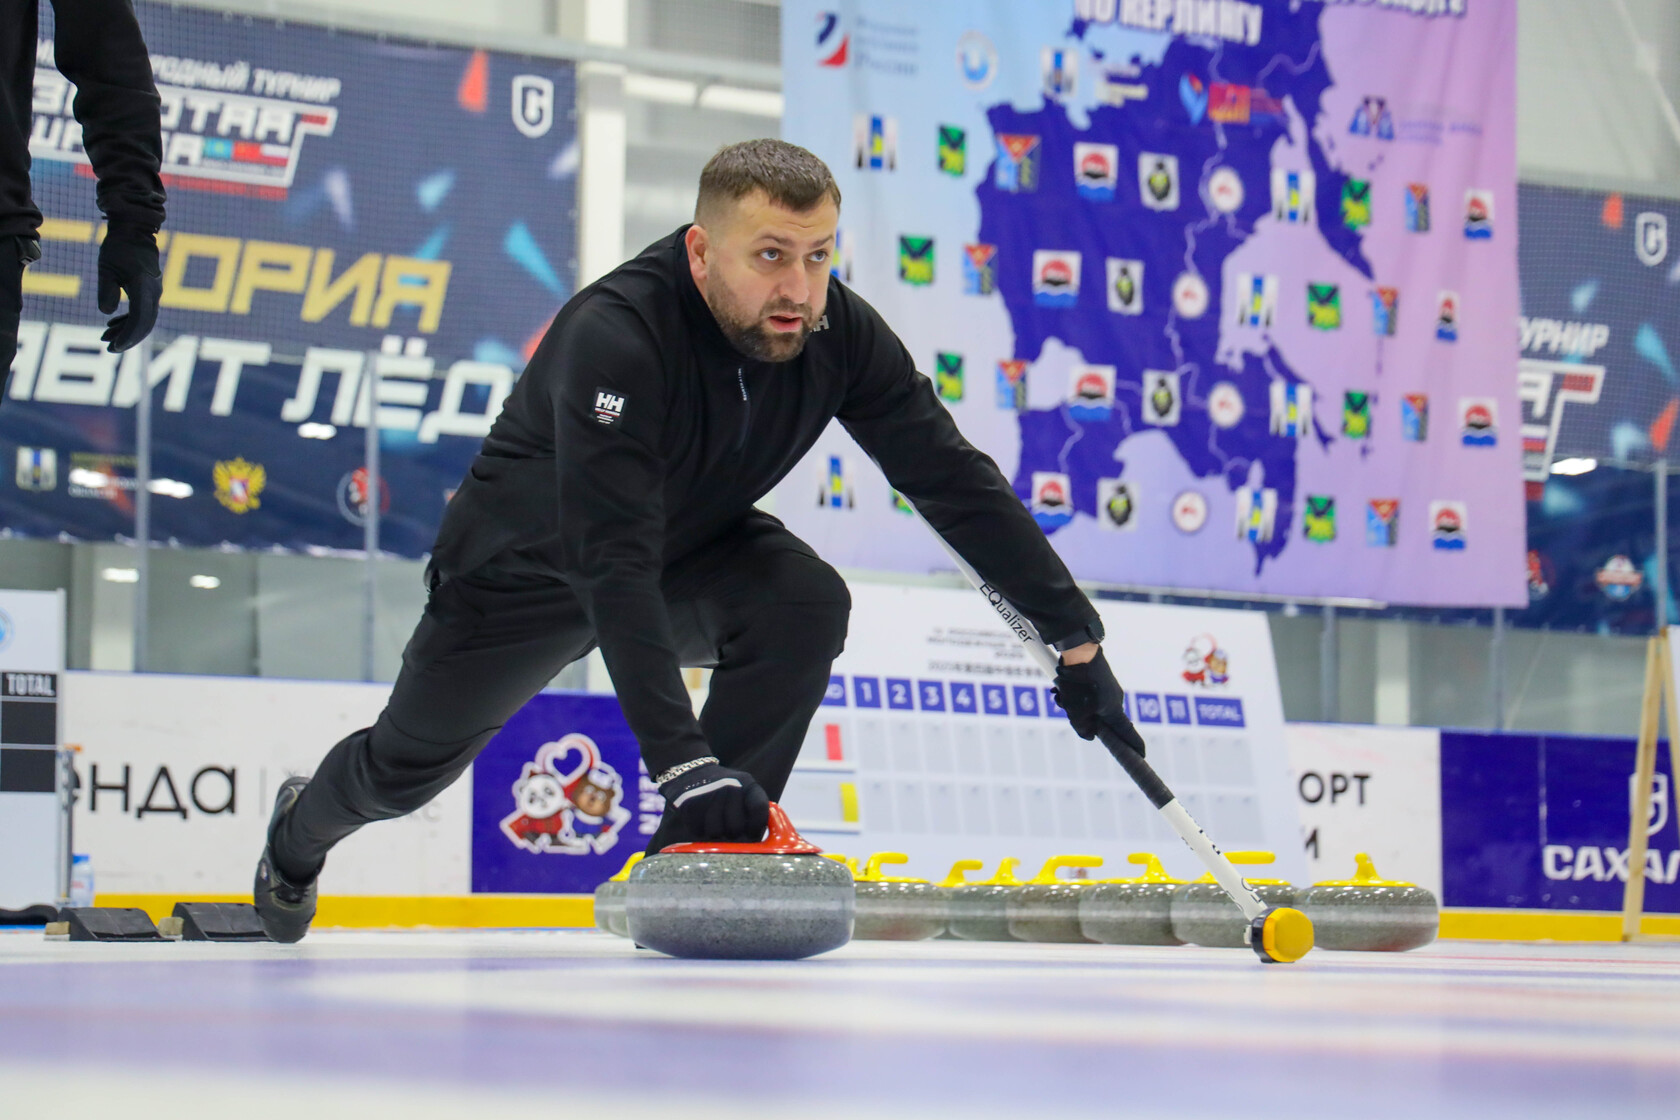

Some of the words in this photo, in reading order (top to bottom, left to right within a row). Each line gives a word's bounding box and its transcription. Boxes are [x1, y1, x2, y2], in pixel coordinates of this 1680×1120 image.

[1520, 317, 1610, 357] УРНИР
[280, 334, 515, 444] ЛЁД
[595, 392, 625, 412] HH
[980, 583, 1033, 643] EQualizer
[6, 673, 56, 696] TOTAL
[860, 681, 873, 703] 1
[891, 683, 908, 704] 2
[923, 685, 940, 707] 3
[955, 687, 971, 708] 4
[987, 689, 1003, 710] 5
[1018, 691, 1035, 712] 6
[1138, 697, 1160, 719] 10
[1170, 699, 1186, 719] 11
[1198, 702, 1242, 722] TOTAL
[1298, 771, 1371, 806] ОРТ
